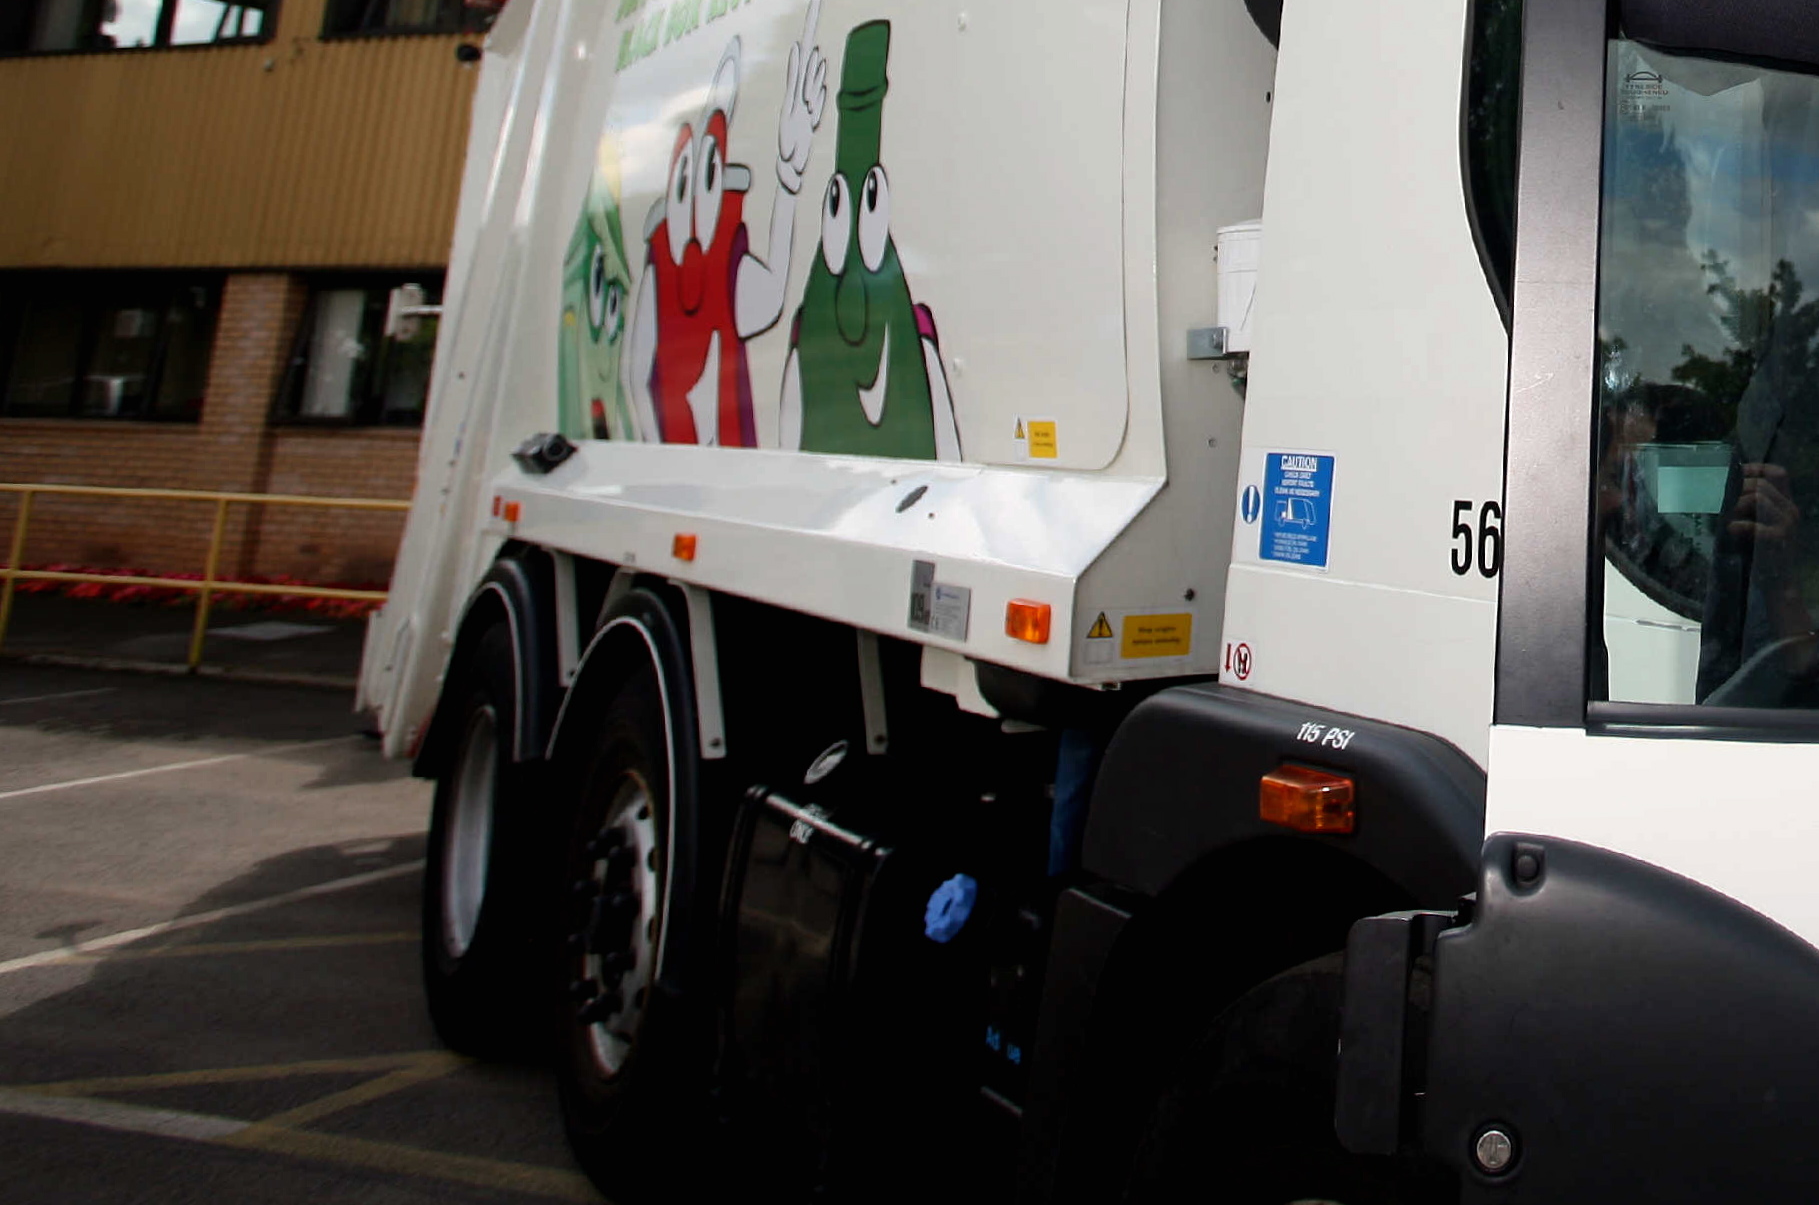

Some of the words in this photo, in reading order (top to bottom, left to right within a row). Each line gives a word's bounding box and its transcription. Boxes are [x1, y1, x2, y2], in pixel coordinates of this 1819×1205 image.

[1281, 455, 1318, 470] CAUTION
[1451, 500, 1501, 578] 56
[1296, 722, 1327, 743] 115
[1321, 727, 1356, 750] PSI
